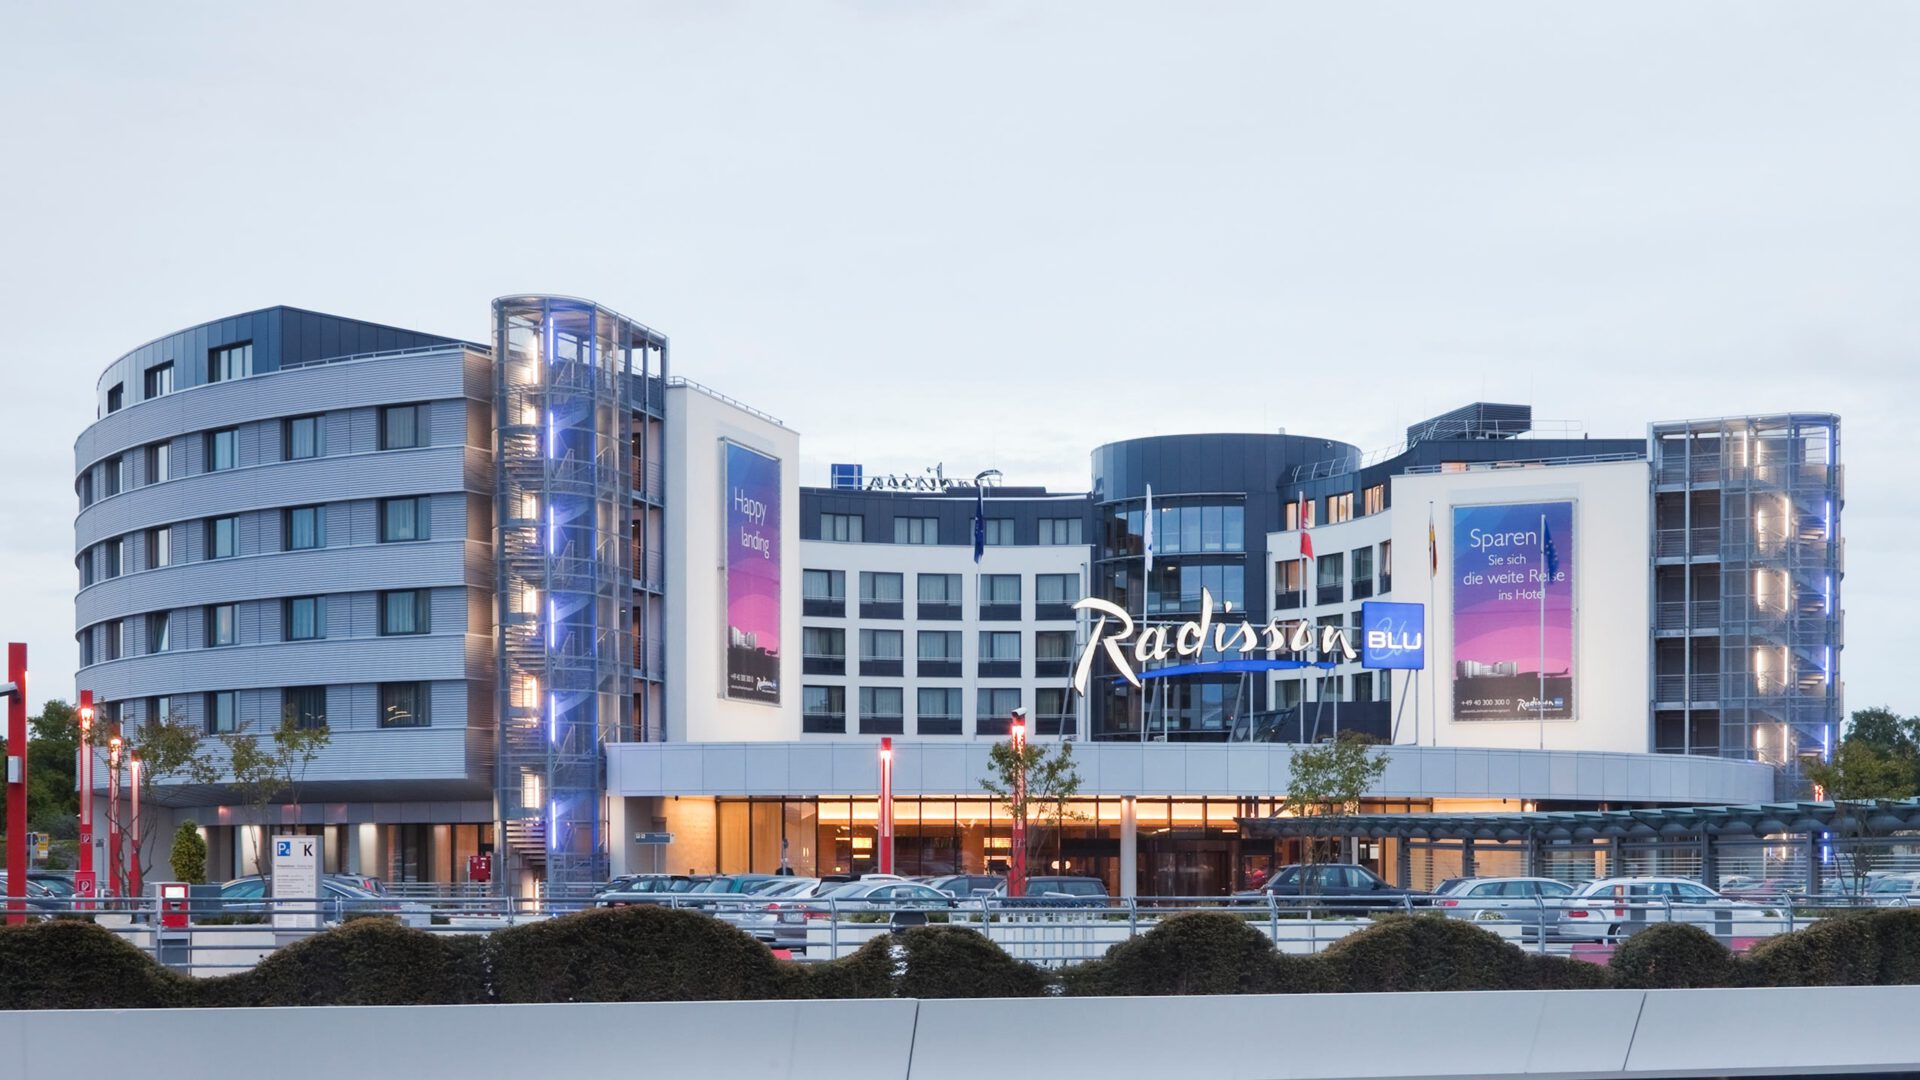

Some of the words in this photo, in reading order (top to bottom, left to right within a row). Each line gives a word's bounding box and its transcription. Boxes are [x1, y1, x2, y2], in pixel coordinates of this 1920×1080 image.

[734, 487, 767, 526] Happy
[741, 526, 770, 559] landing
[1470, 528, 1537, 552] Sparen
[1488, 554, 1503, 566] Sie
[1506, 554, 1527, 565] sich
[1463, 570, 1483, 585] die
[1487, 570, 1524, 584] weite
[1498, 589, 1513, 601] ins
[1072, 585, 1358, 697] Radisson
[1368, 631, 1421, 650] BLU
[1517, 696, 1554, 712] Radison
[304, 844, 313, 856] K
